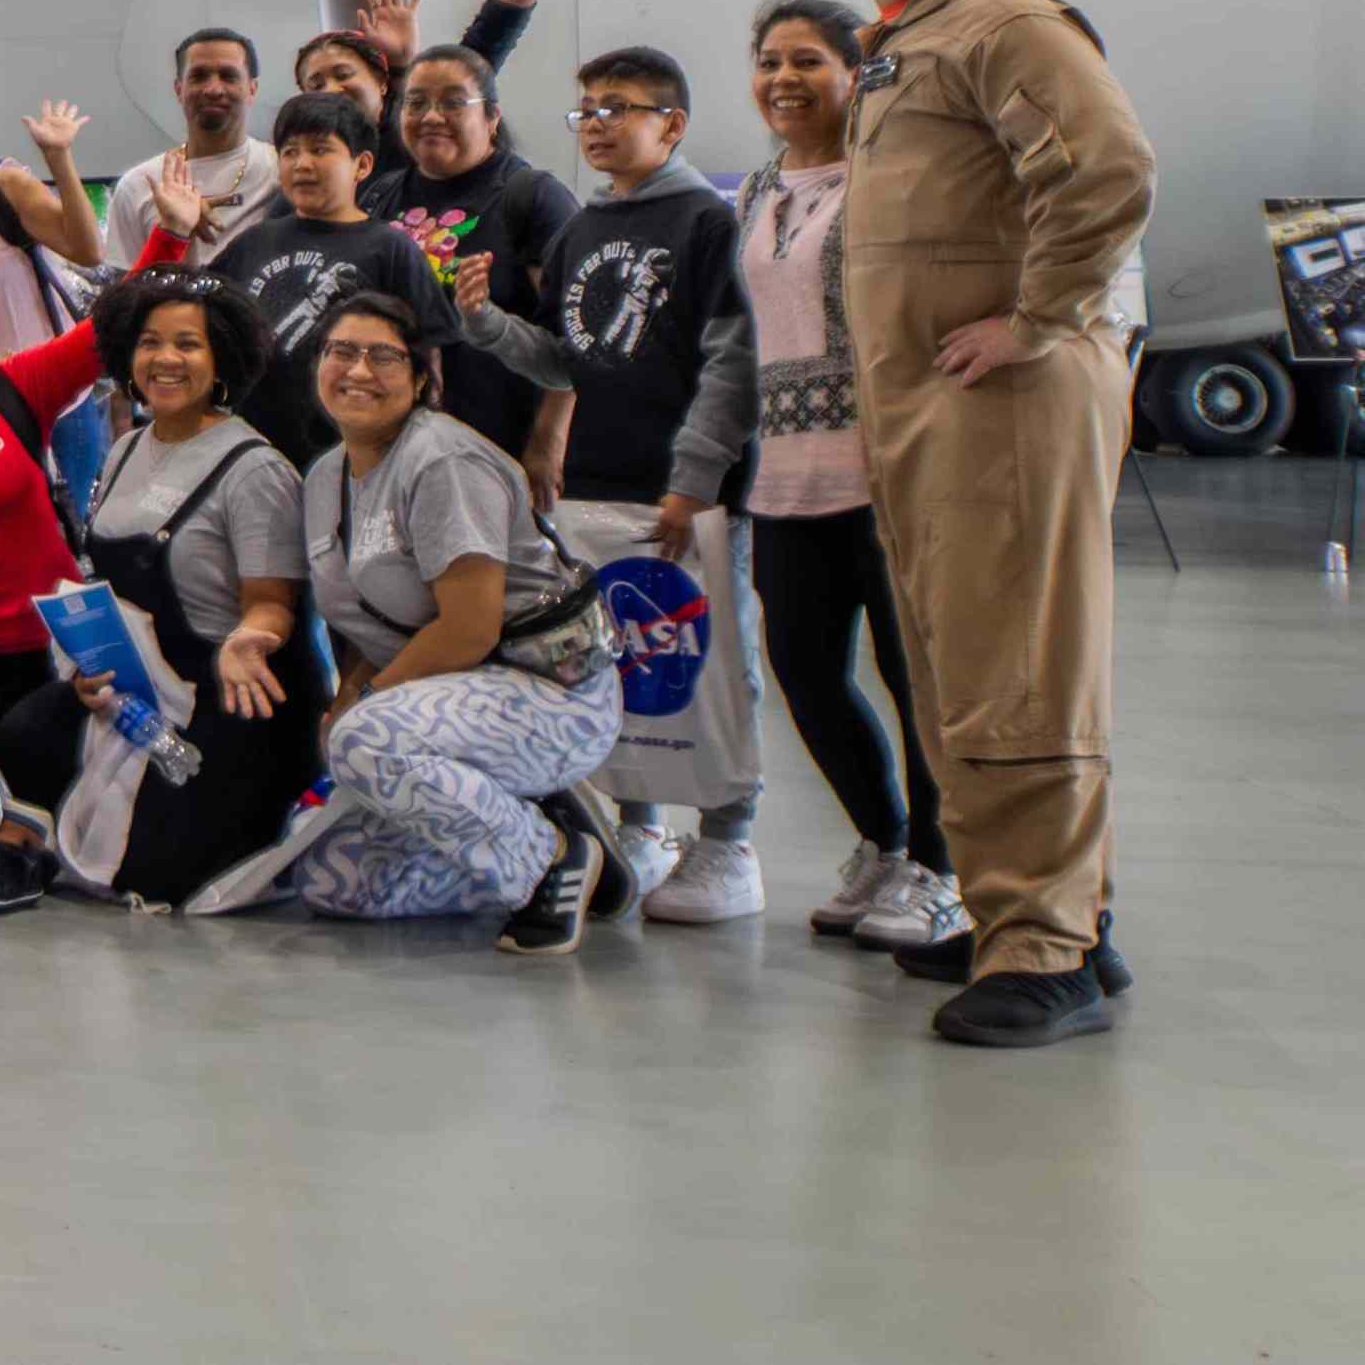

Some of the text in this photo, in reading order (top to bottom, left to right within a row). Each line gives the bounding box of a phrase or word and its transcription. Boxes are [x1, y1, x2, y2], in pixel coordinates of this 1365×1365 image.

[261, 255, 291, 278] FAR
[294, 251, 324, 267] OUT
[565, 240, 631, 351] SPACE IS FAR OUT
